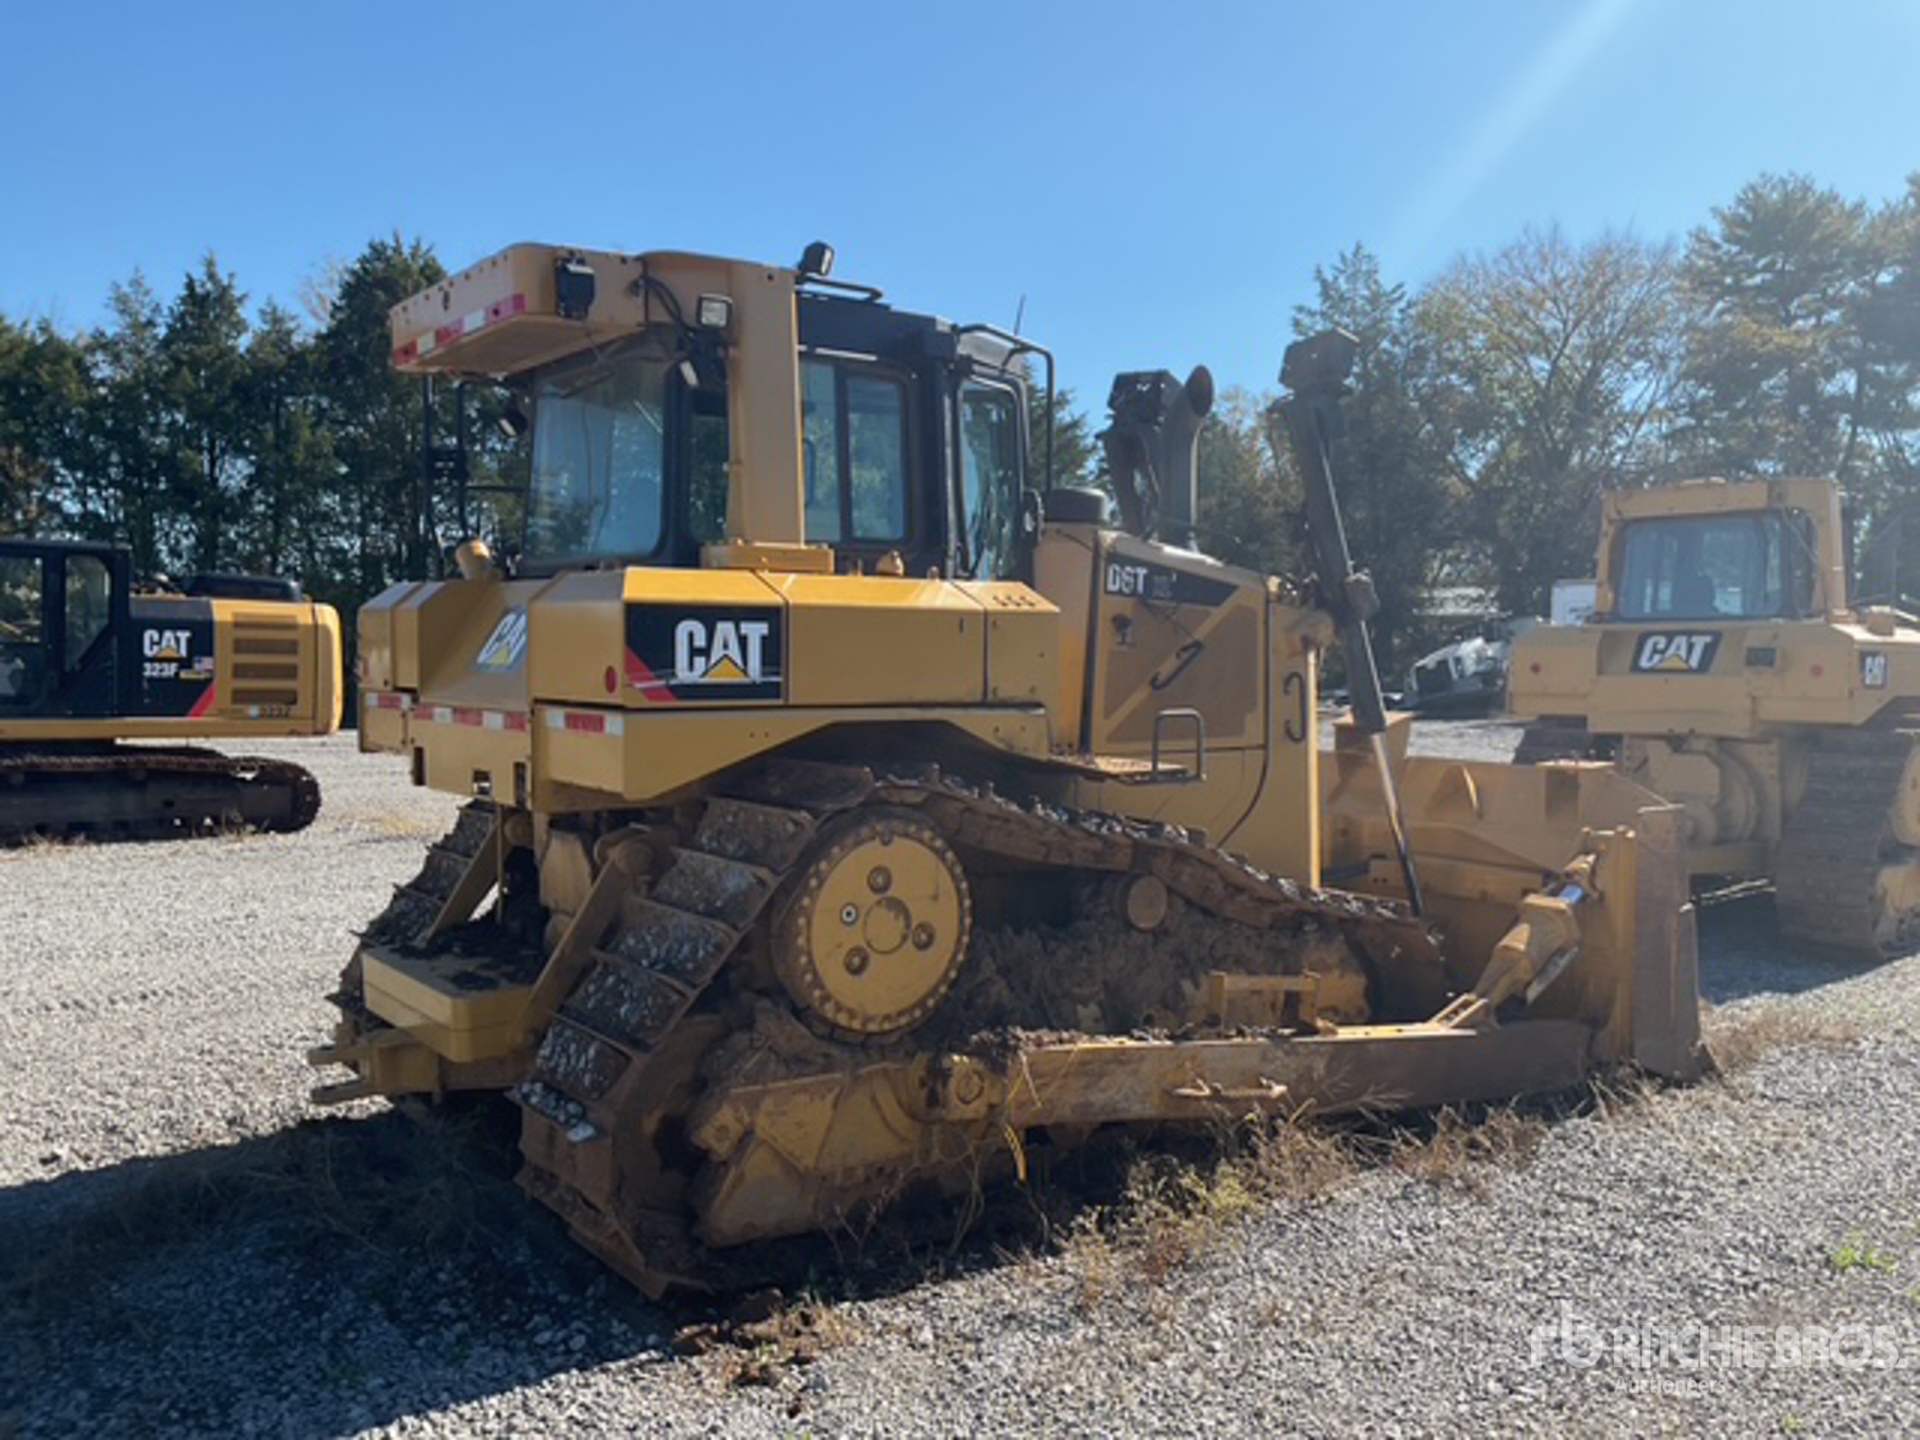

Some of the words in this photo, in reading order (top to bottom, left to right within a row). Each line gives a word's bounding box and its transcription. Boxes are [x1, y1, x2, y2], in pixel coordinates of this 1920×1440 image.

[142, 629, 192, 659] CAT
[673, 618, 770, 685] CAT
[1637, 634, 1712, 671] CAT
